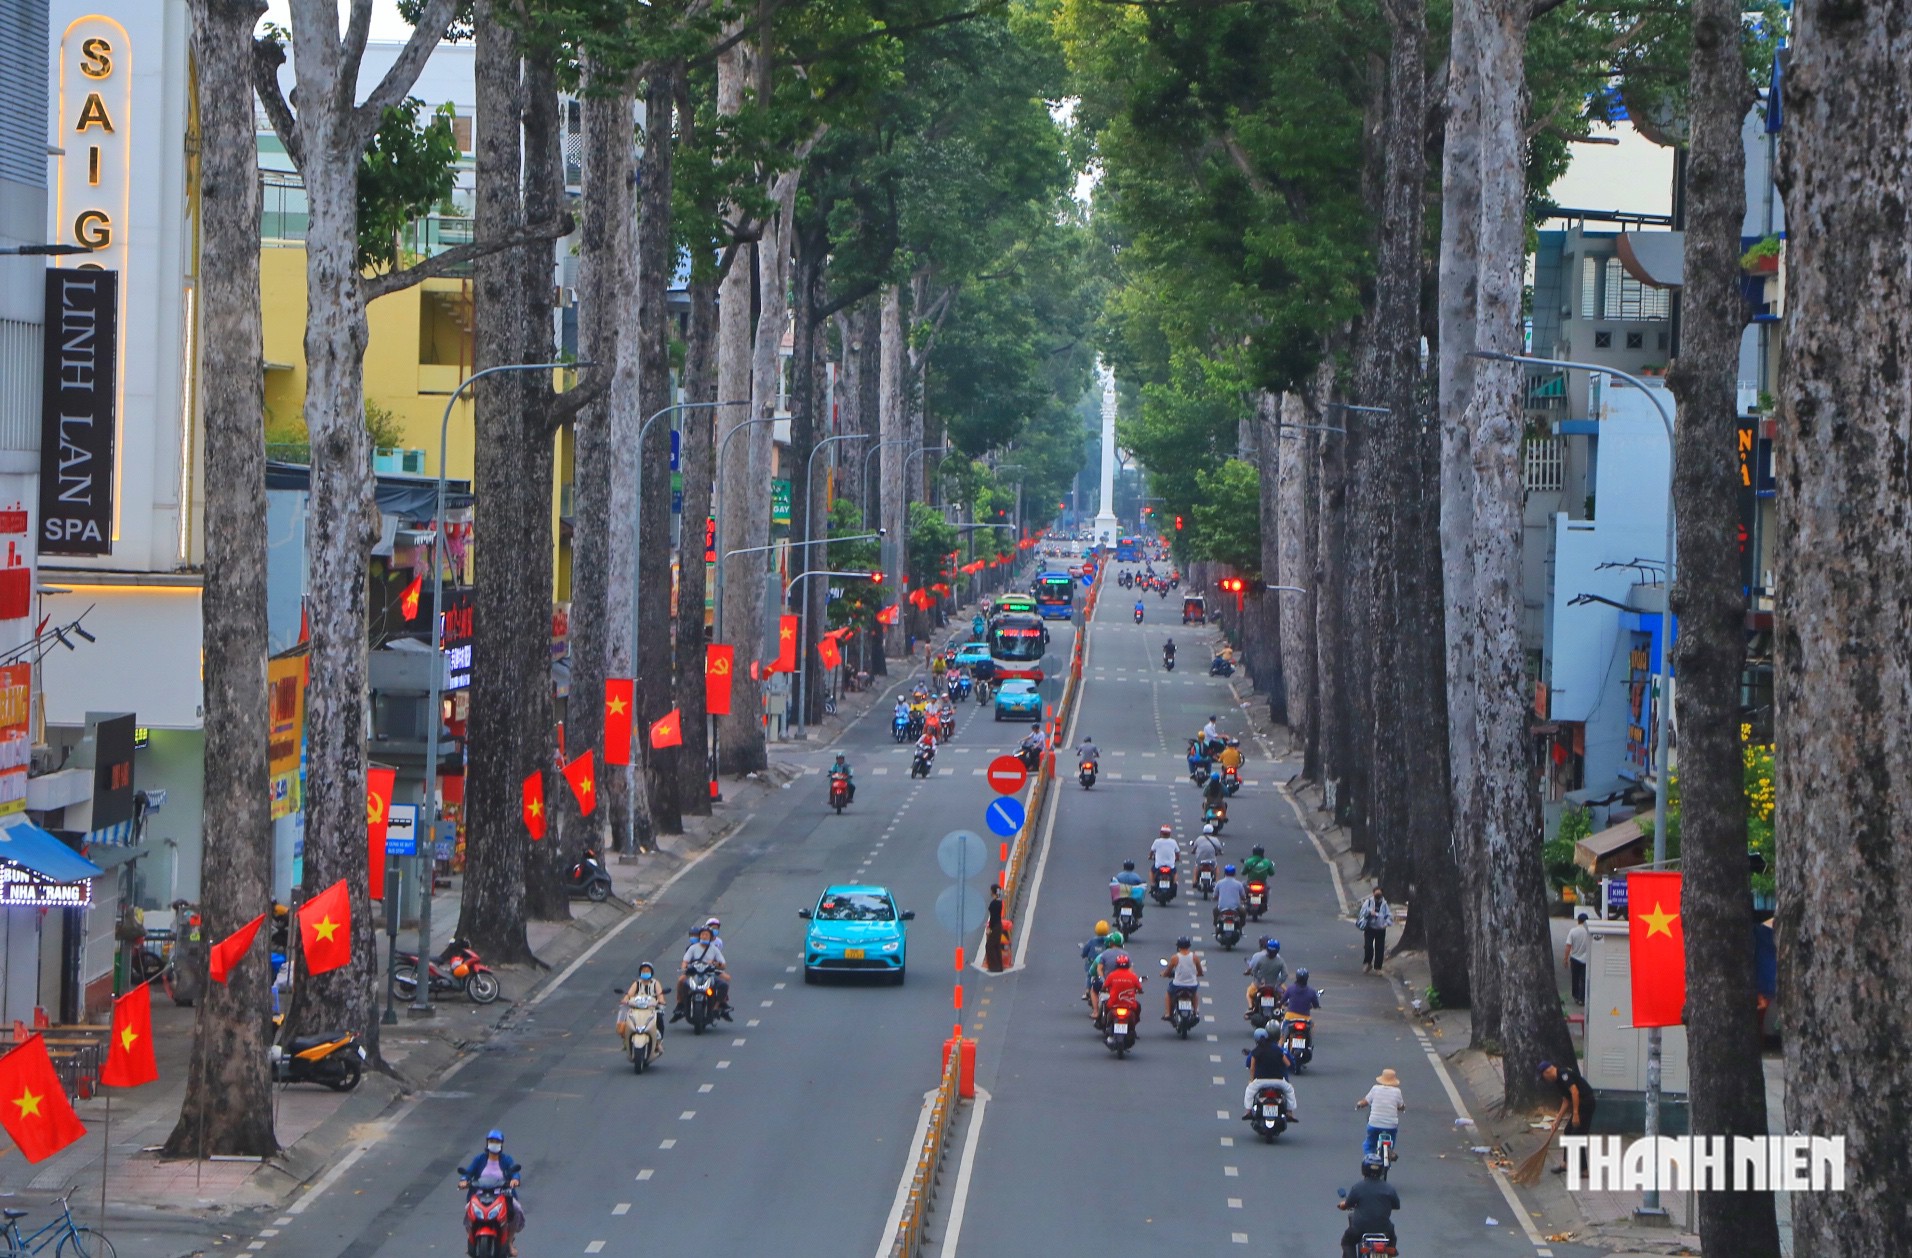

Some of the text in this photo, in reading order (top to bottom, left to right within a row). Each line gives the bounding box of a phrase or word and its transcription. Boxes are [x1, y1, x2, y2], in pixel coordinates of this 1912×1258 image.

[58, 278, 96, 506] LINH LAN
[44, 517, 102, 541] SPA
[10, 885, 36, 900] NHA
[1612, 888, 1625, 897] KHU
